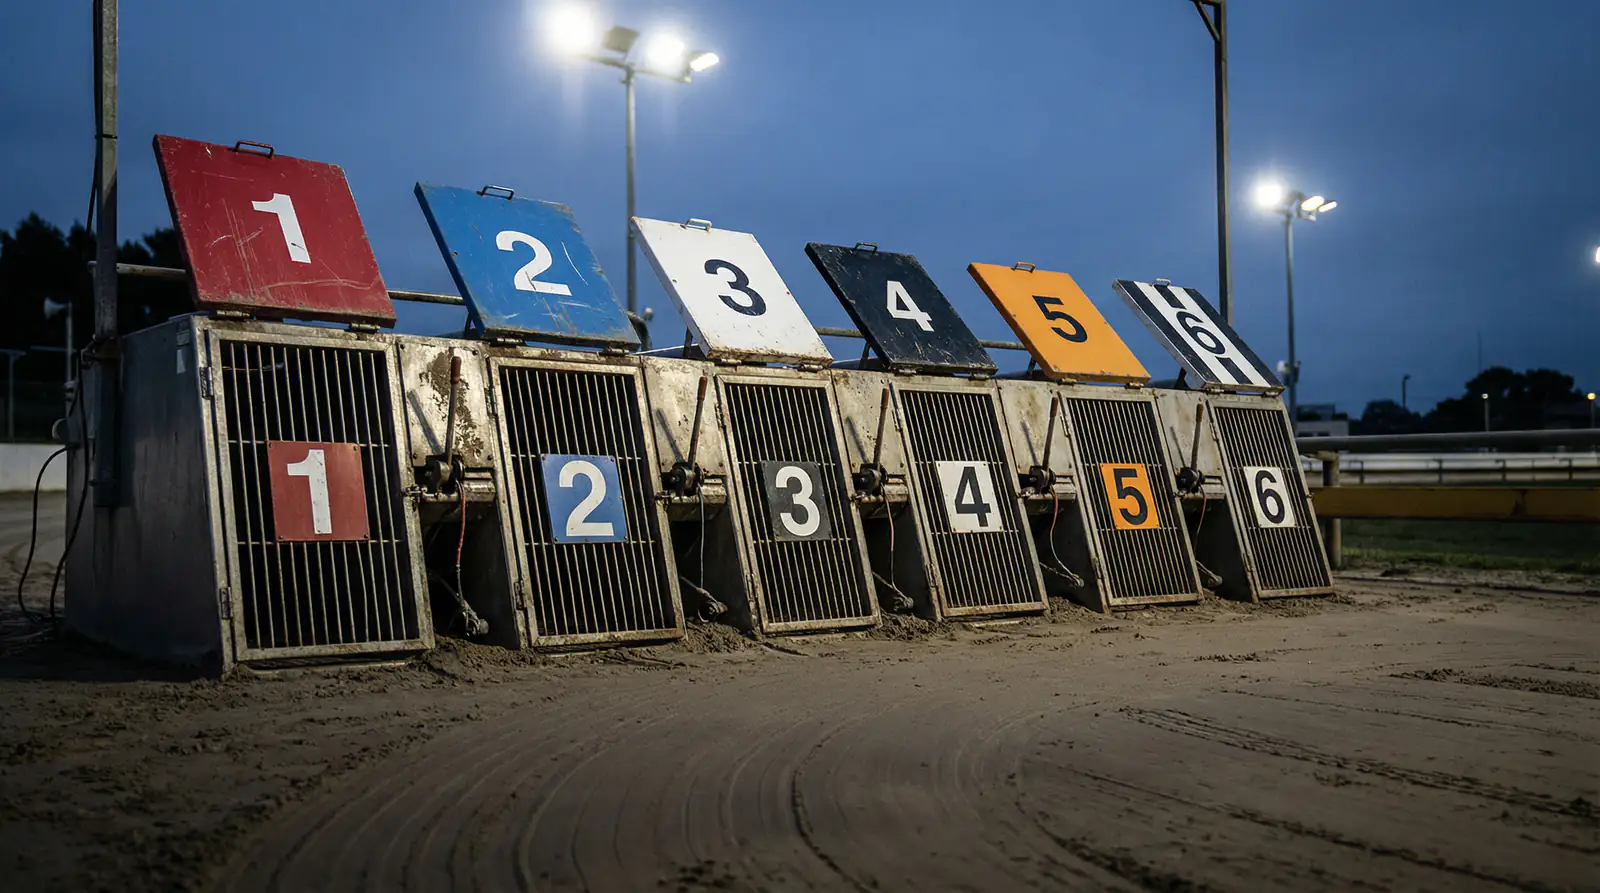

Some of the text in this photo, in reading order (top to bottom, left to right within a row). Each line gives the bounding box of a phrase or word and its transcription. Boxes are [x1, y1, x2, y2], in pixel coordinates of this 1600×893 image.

[252, 193, 311, 264] 1
[495, 231, 573, 297] 2
[704, 259, 767, 316] 3
[886, 280, 934, 332] 4
[1033, 295, 1088, 343] 5
[1176, 311, 1226, 355] 6
[287, 449, 332, 535] 1
[558, 460, 615, 537] 2
[774, 465, 821, 537] 3
[954, 466, 991, 527] 4
[1113, 467, 1149, 525] 5
[1254, 470, 1285, 524] 6
